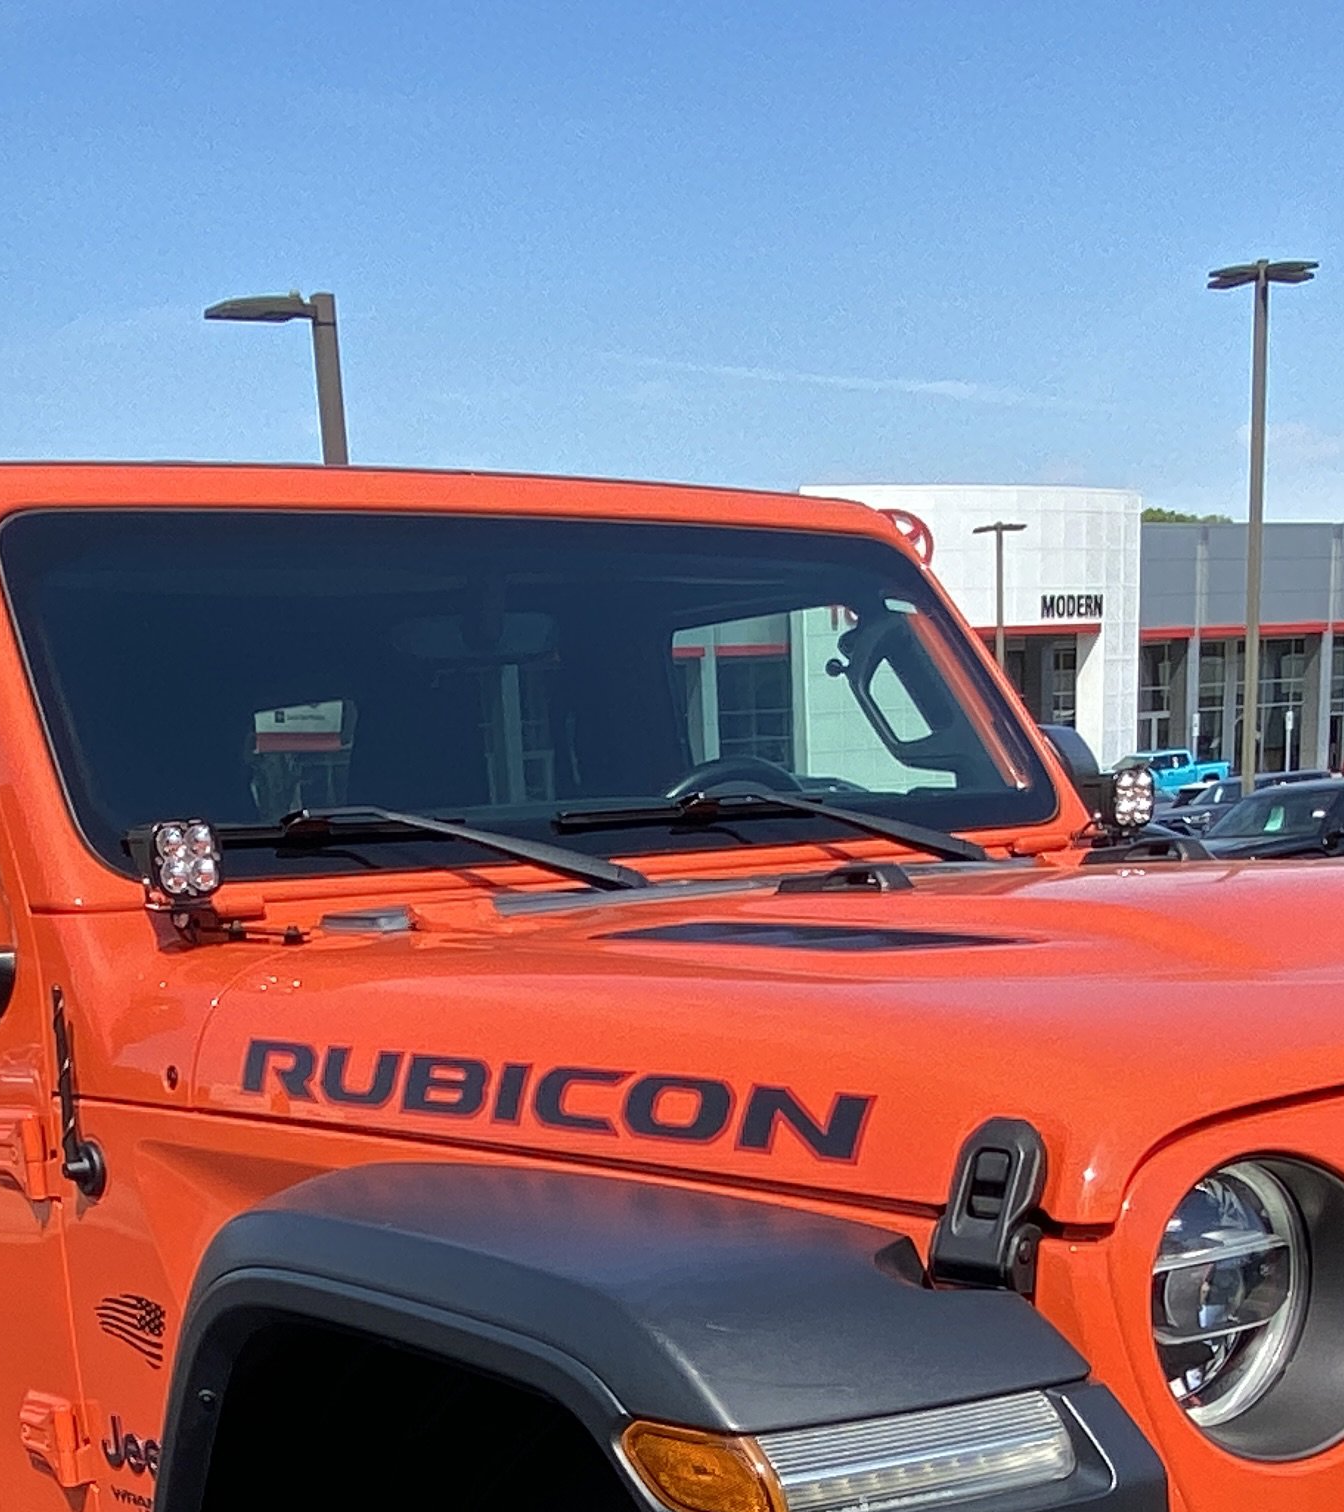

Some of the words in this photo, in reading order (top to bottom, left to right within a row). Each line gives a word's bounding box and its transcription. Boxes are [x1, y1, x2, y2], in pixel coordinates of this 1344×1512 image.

[1041, 593, 1103, 619] MODERN
[240, 1037, 878, 1166] RUBICON
[101, 1414, 162, 1481] Jee
